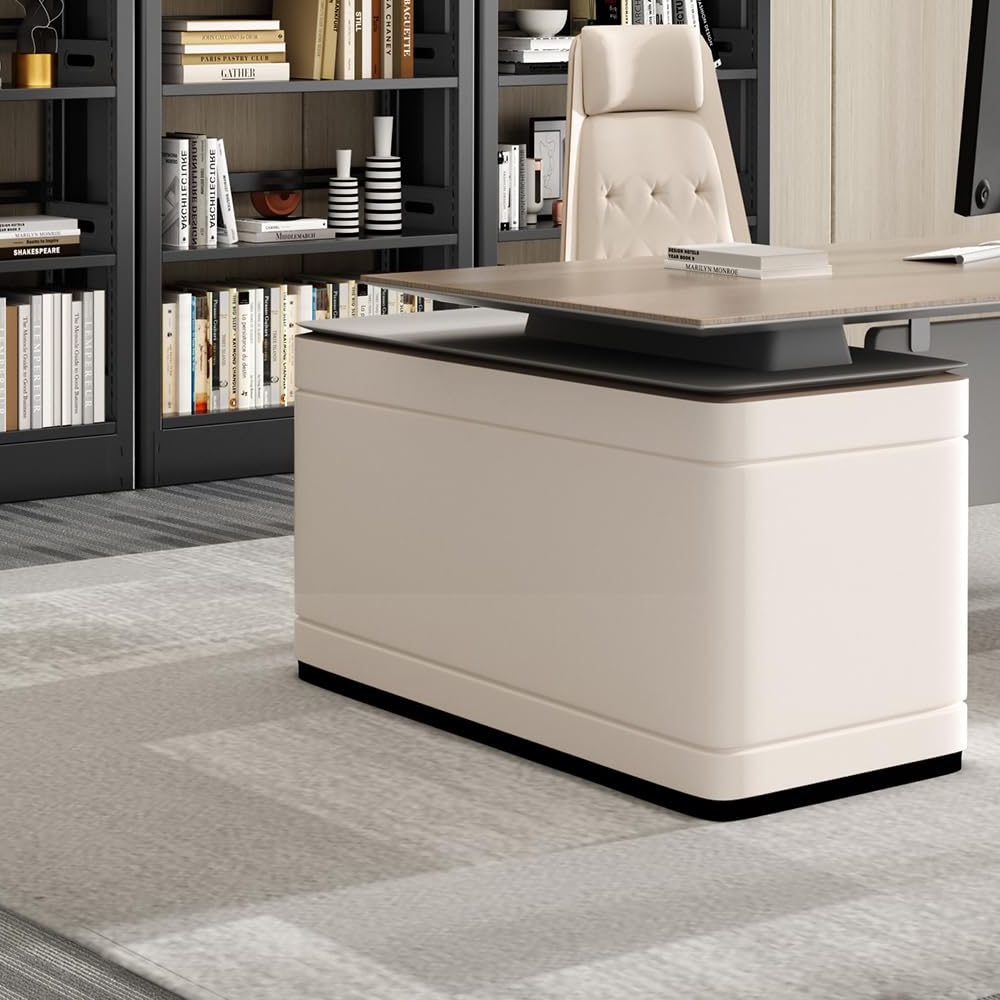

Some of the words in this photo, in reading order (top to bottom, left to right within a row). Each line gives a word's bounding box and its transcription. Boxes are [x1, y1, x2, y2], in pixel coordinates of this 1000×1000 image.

[704, 24, 713, 46] DESIGN
[221, 68, 256, 78] GATHER
[13, 246, 60, 256] SHAKESPEARE
[685, 263, 712, 273] MARILYN
[713, 266, 739, 276] MONROE
